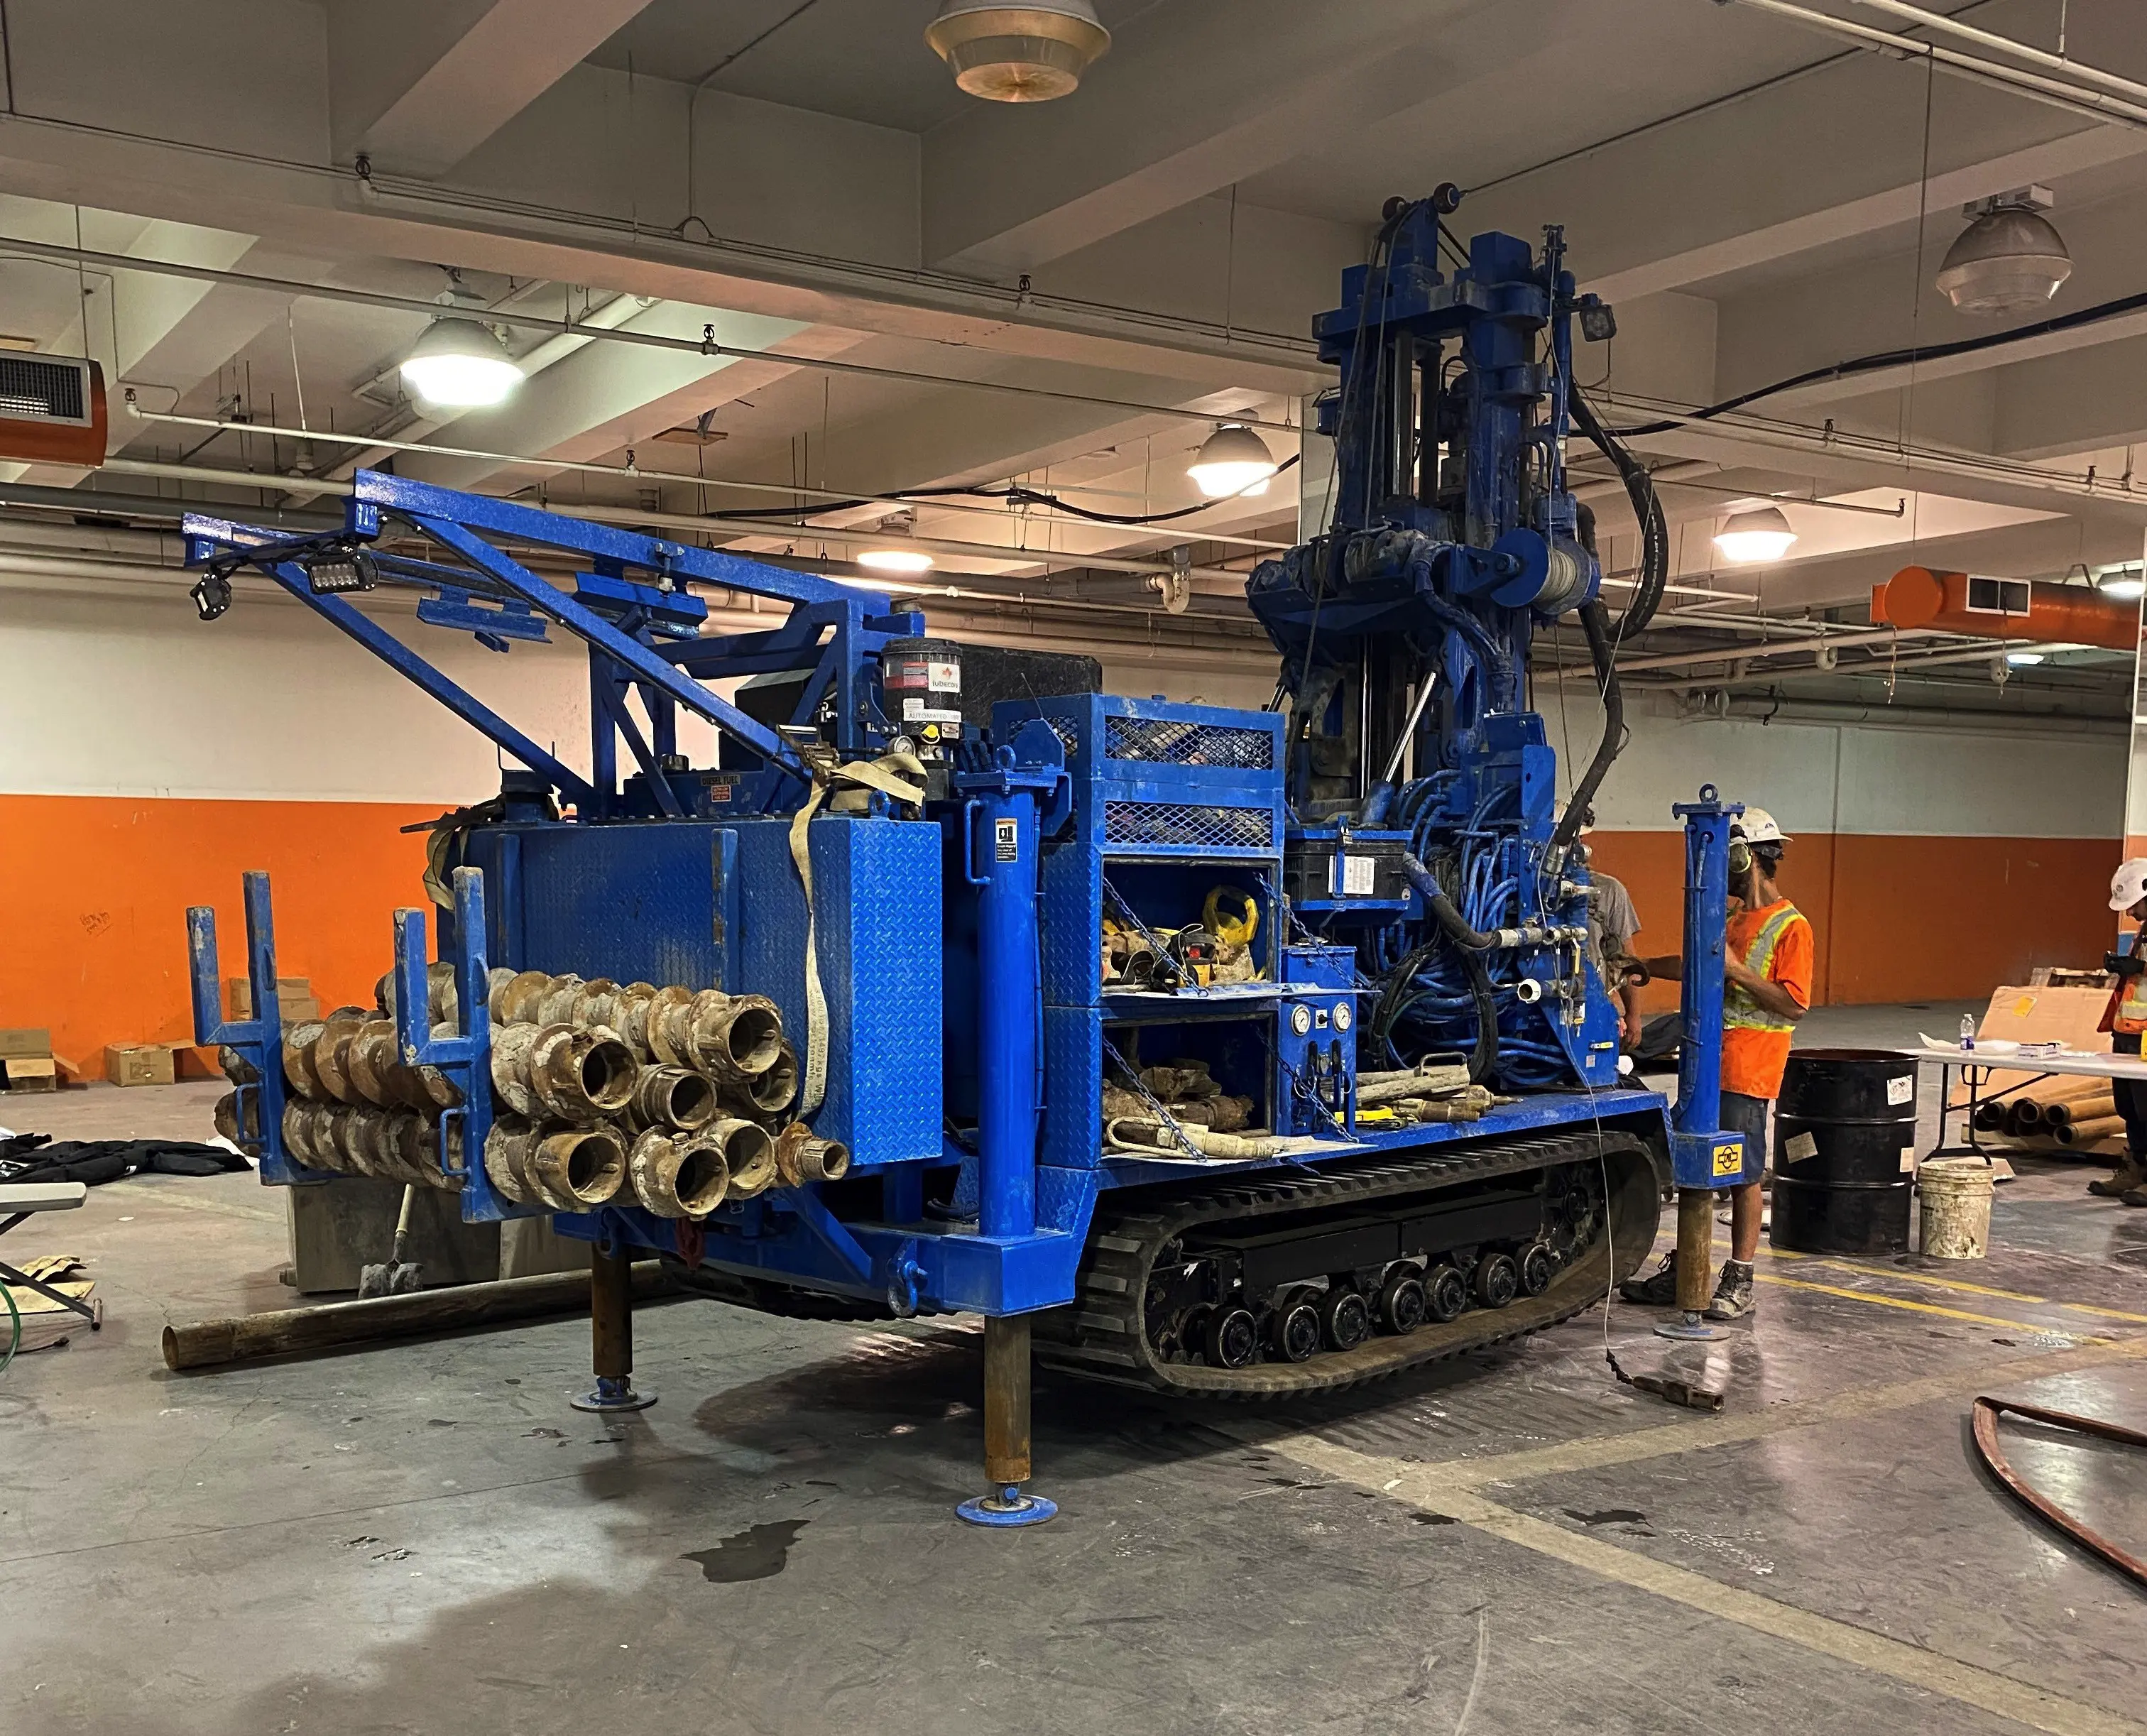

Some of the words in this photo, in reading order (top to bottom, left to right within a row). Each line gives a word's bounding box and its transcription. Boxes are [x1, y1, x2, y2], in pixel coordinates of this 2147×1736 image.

[932, 680, 958, 689] lubecon
[702, 776, 721, 785] DIESEL
[723, 775, 738, 785] FUEL
